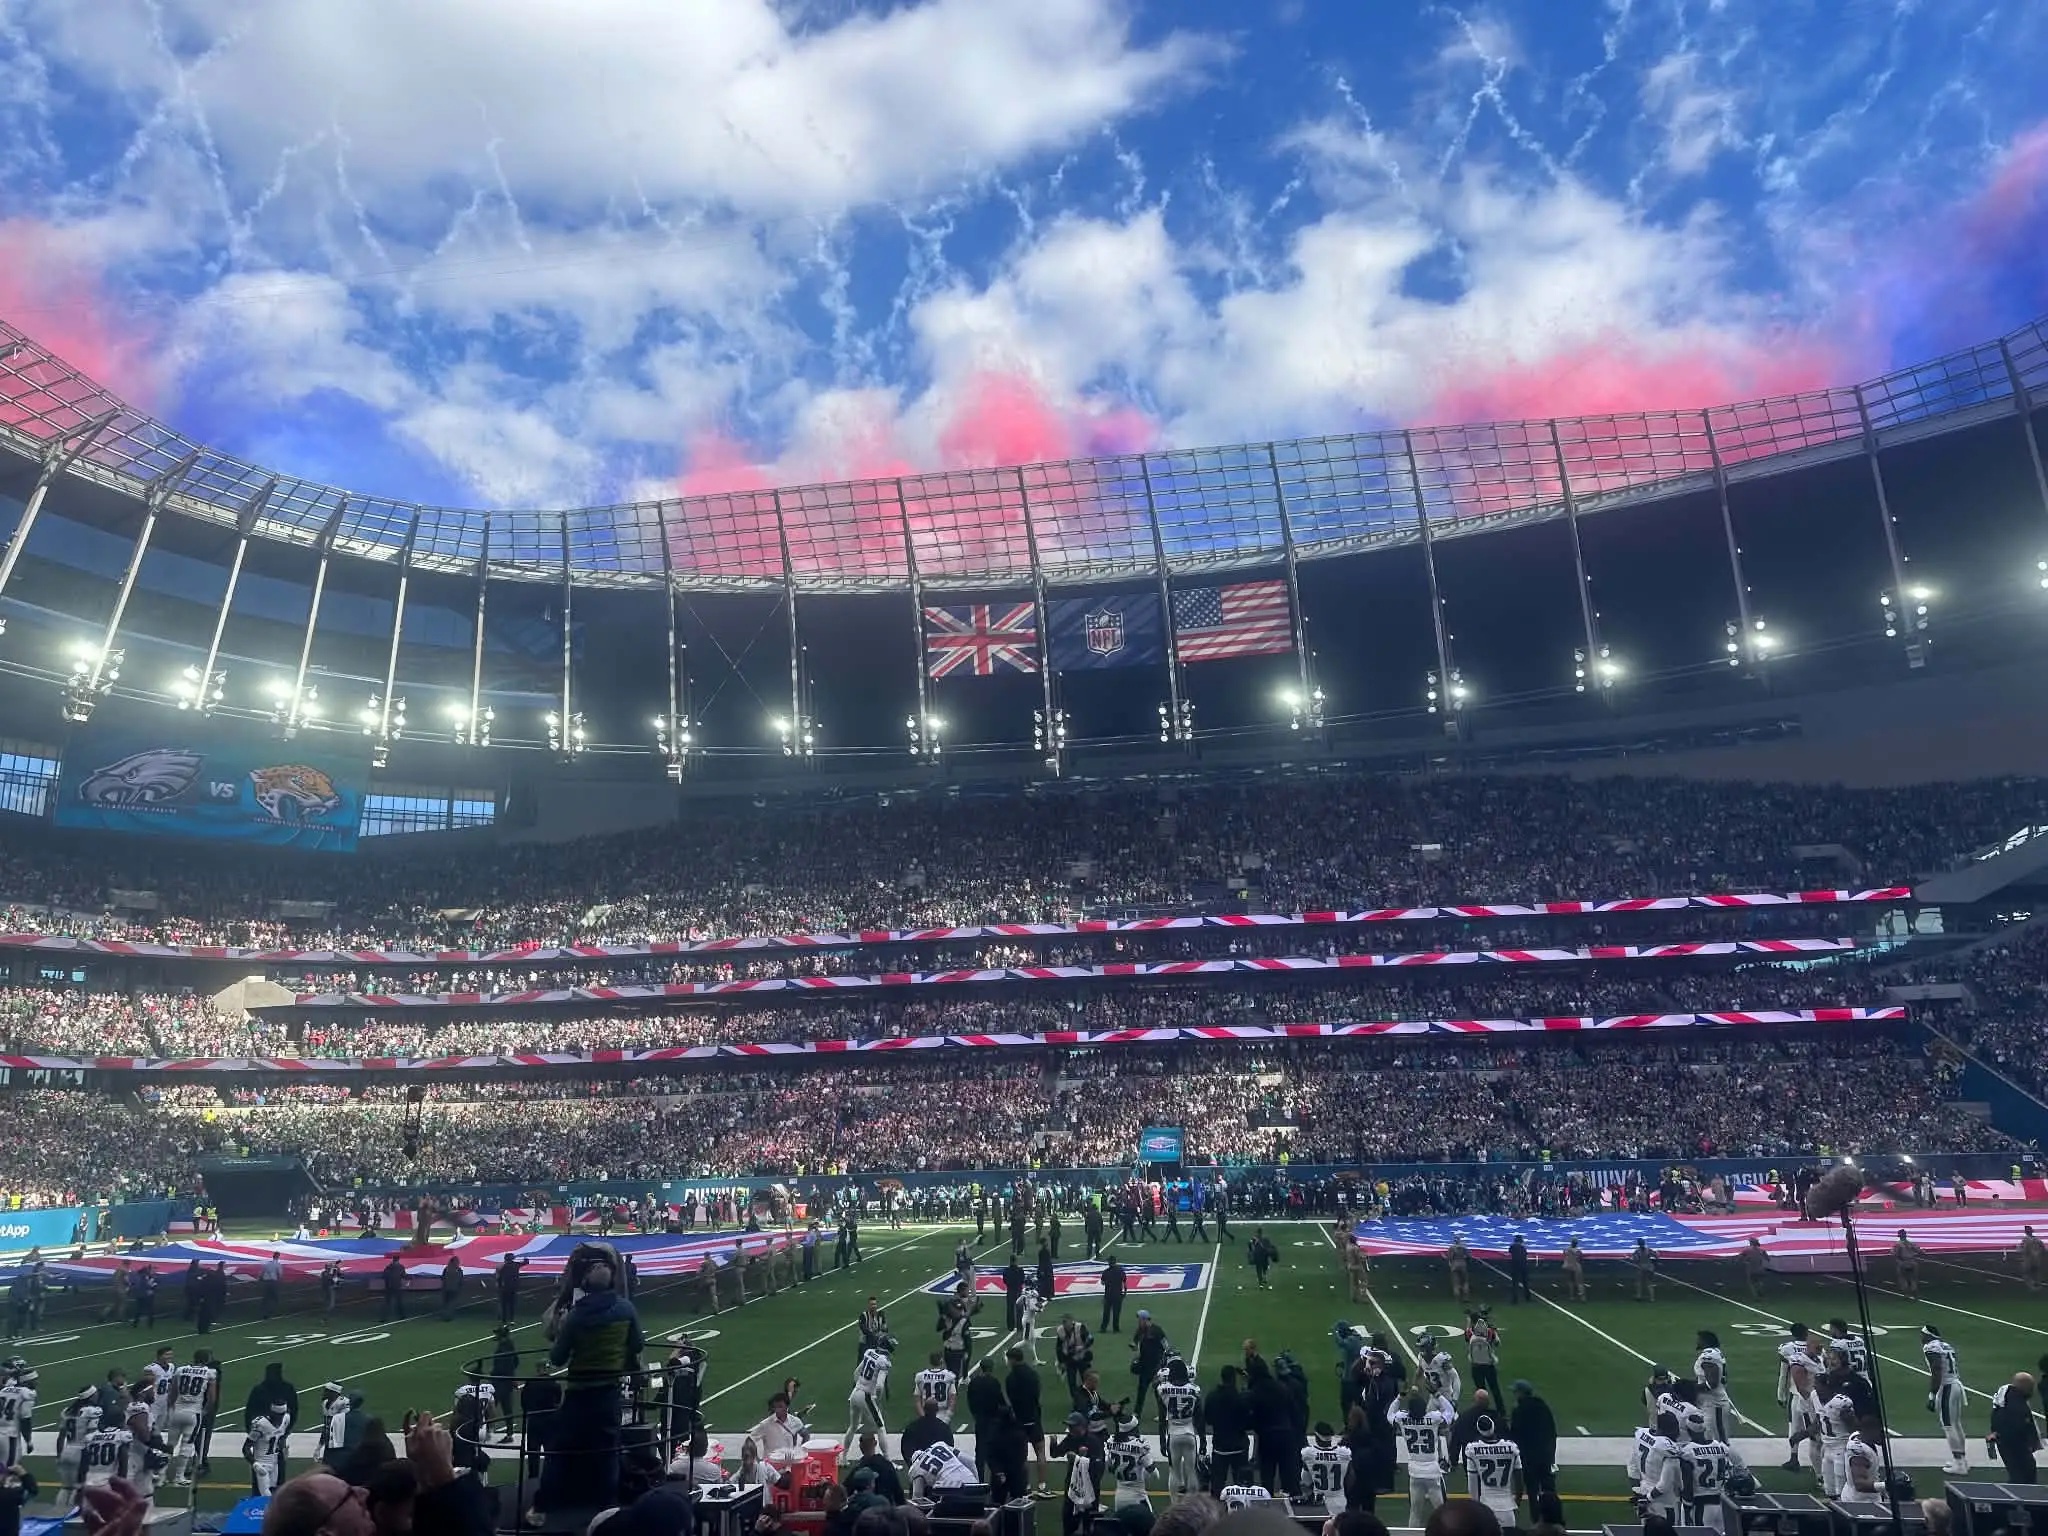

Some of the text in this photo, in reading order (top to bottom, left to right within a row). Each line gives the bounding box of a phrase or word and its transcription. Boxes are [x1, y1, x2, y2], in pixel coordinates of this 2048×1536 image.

[1089, 629, 1121, 650] NFL
[210, 781, 235, 798] VS
[0, 1223, 31, 1238] tApp
[1404, 1429, 1435, 1454] 23
[1474, 1446, 1513, 1455] MITCHELL
[1315, 1452, 1338, 1461] JONES
[1639, 1444, 1650, 1475] 7
[1312, 1463, 1342, 1491] 31
[1480, 1458, 1512, 1487] 27
